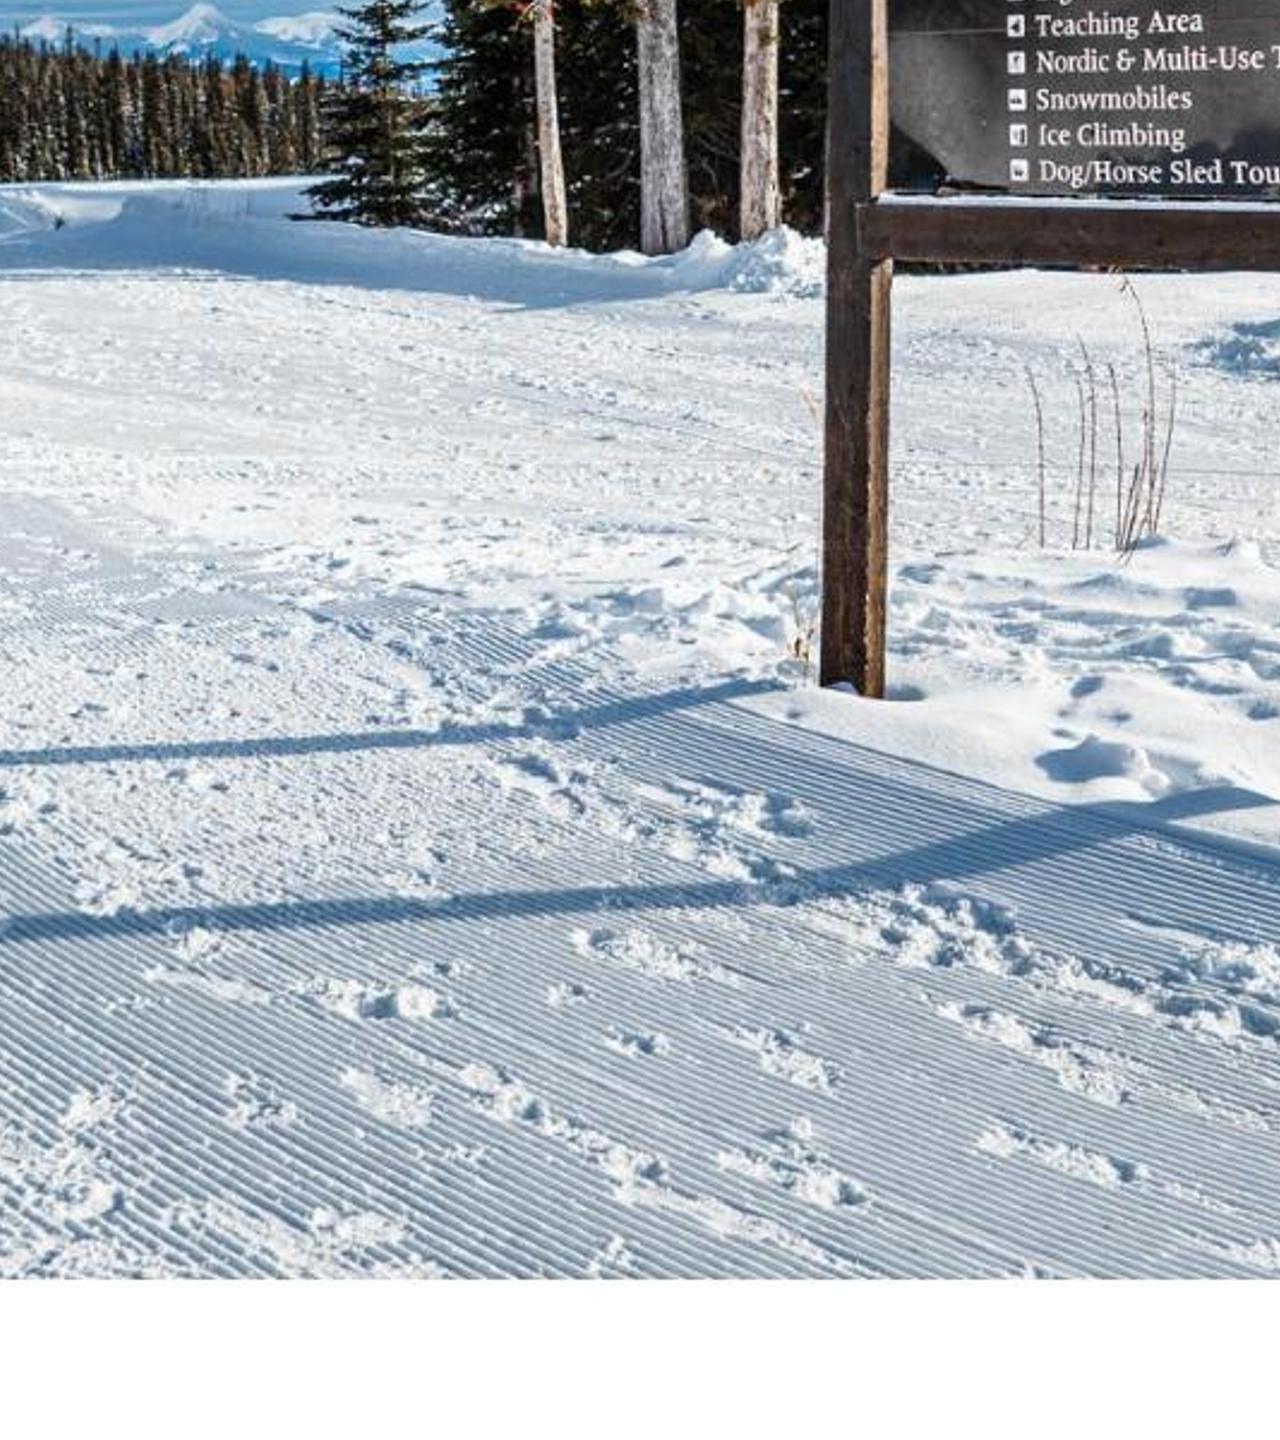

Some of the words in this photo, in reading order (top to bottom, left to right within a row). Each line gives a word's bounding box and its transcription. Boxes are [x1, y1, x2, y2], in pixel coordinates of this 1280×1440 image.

[1035, 12, 1140, 39] Teaching
[1146, 10, 1204, 34] Area
[1036, 48, 1109, 73] Nordic
[1116, 48, 1134, 71] &
[1142, 45, 1265, 71] Multi-Use
[1036, 85, 1193, 111] Snowmobiles
[1039, 124, 1070, 147] Ice
[1077, 122, 1185, 153] Climbing
[1039, 159, 1162, 189] Dog/Horse
[1169, 158, 1223, 184] Sled
